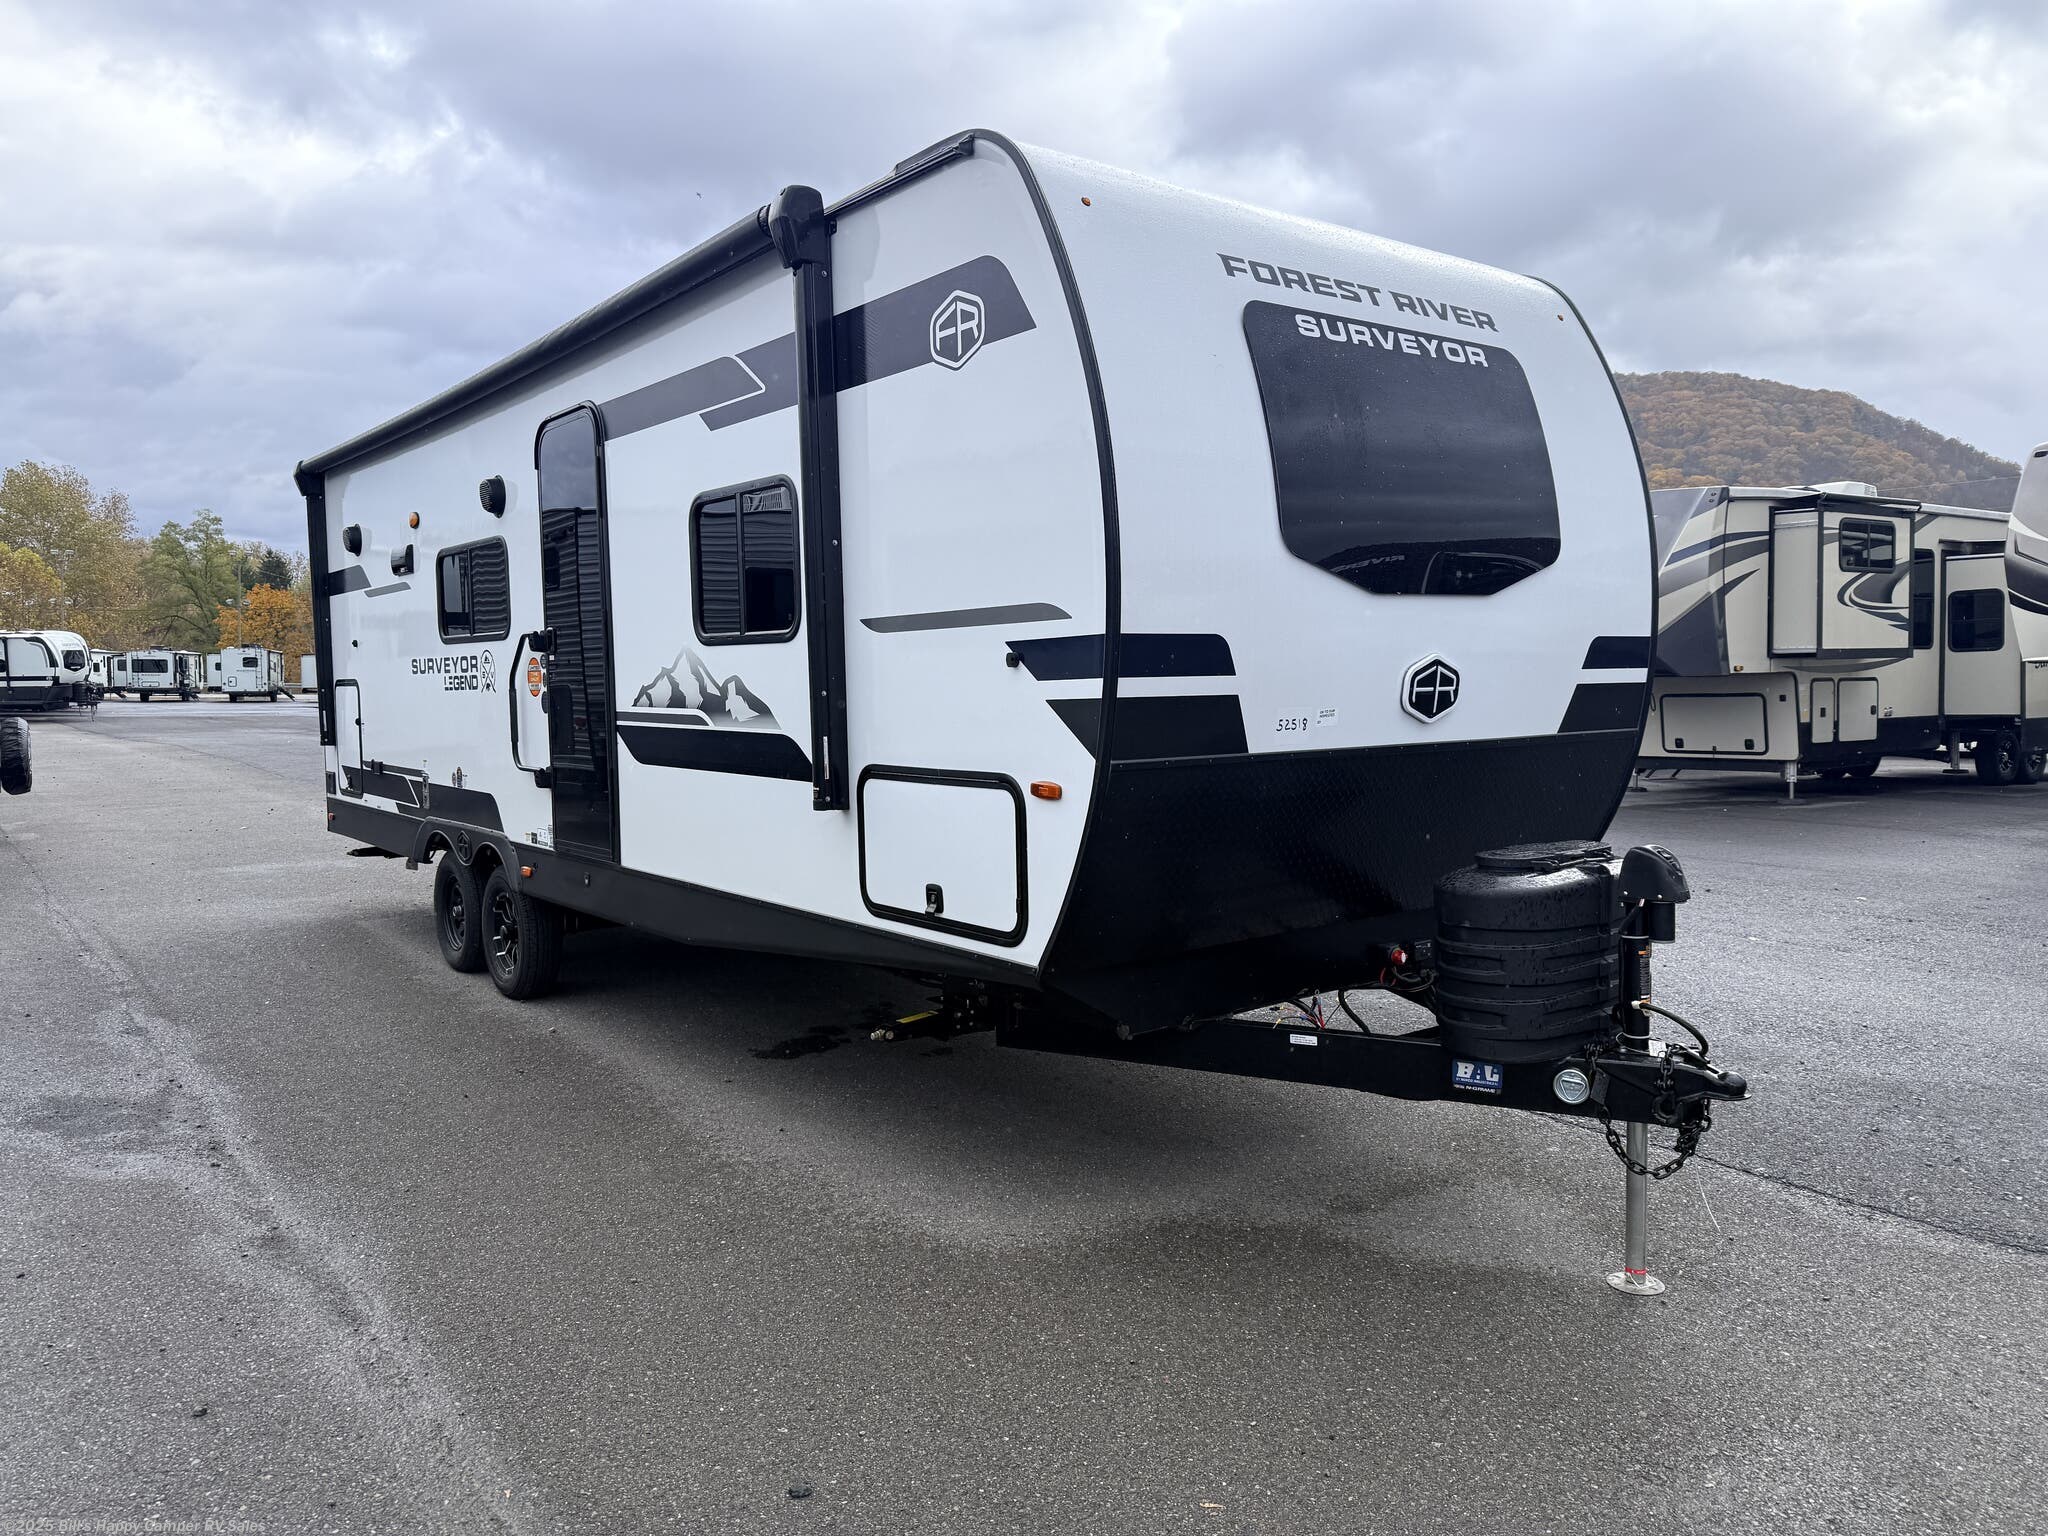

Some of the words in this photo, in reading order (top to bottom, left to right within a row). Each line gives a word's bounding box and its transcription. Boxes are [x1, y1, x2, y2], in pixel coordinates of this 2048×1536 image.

[1216, 252, 1382, 307] FOREST
[1388, 290, 1500, 333] RIVER
[1295, 314, 1489, 368] SURVEYOR
[411, 655, 479, 675] SURVEYOR
[444, 674, 479, 691] LEGEND
[1276, 718, 1308, 732] 52518
